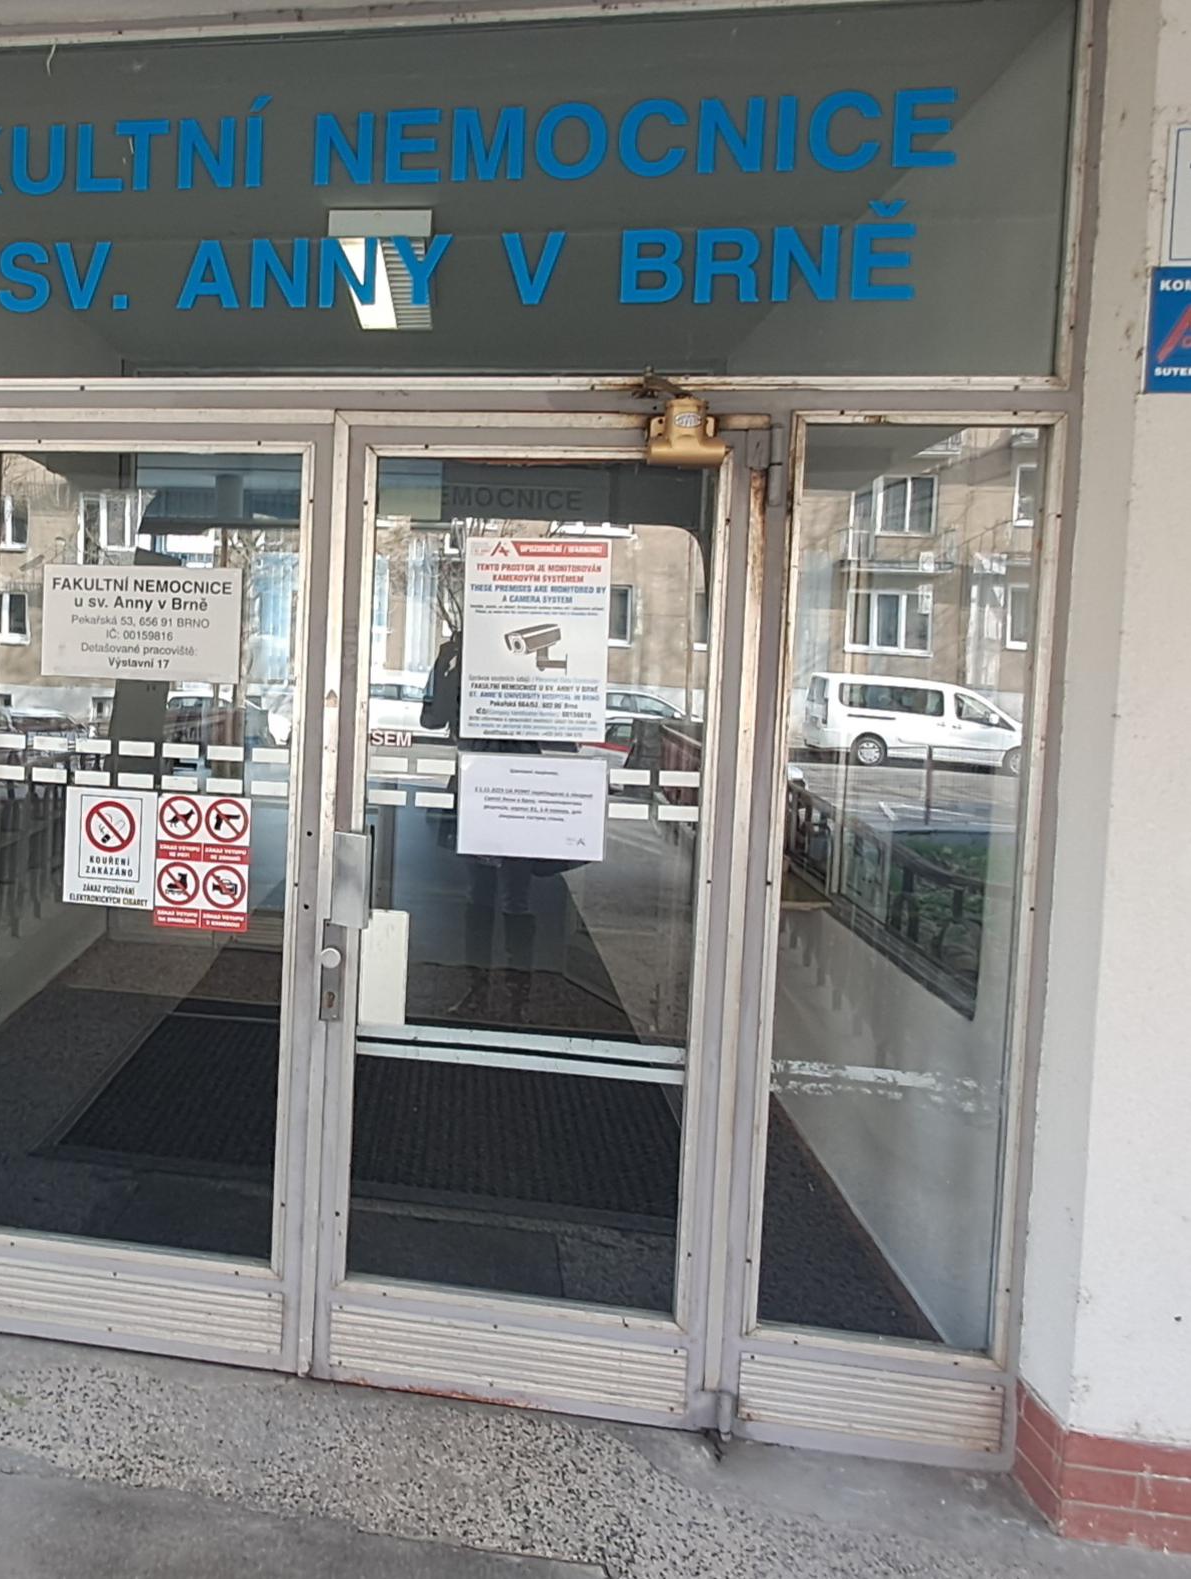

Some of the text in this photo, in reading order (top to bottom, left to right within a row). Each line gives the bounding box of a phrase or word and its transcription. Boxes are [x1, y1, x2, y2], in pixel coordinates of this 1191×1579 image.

[314, 89, 958, 186] NEMOCNICE
[176, 234, 452, 310] ANNY
[503, 232, 564, 306] V
[619, 201, 917, 306] BRNĚ
[1155, 367, 1191, 376] SUTE
[52, 576, 232, 595] FAKULTNÍ NEMOCNICE
[74, 597, 208, 612] u sv. Anny v Brně
[72, 615, 209, 628] Pekařská 53, 656 91 BRNO
[106, 628, 173, 641] IČ: 00159816
[109, 657, 169, 669] Výstavní 17
[372, 732, 410, 745] SEM
